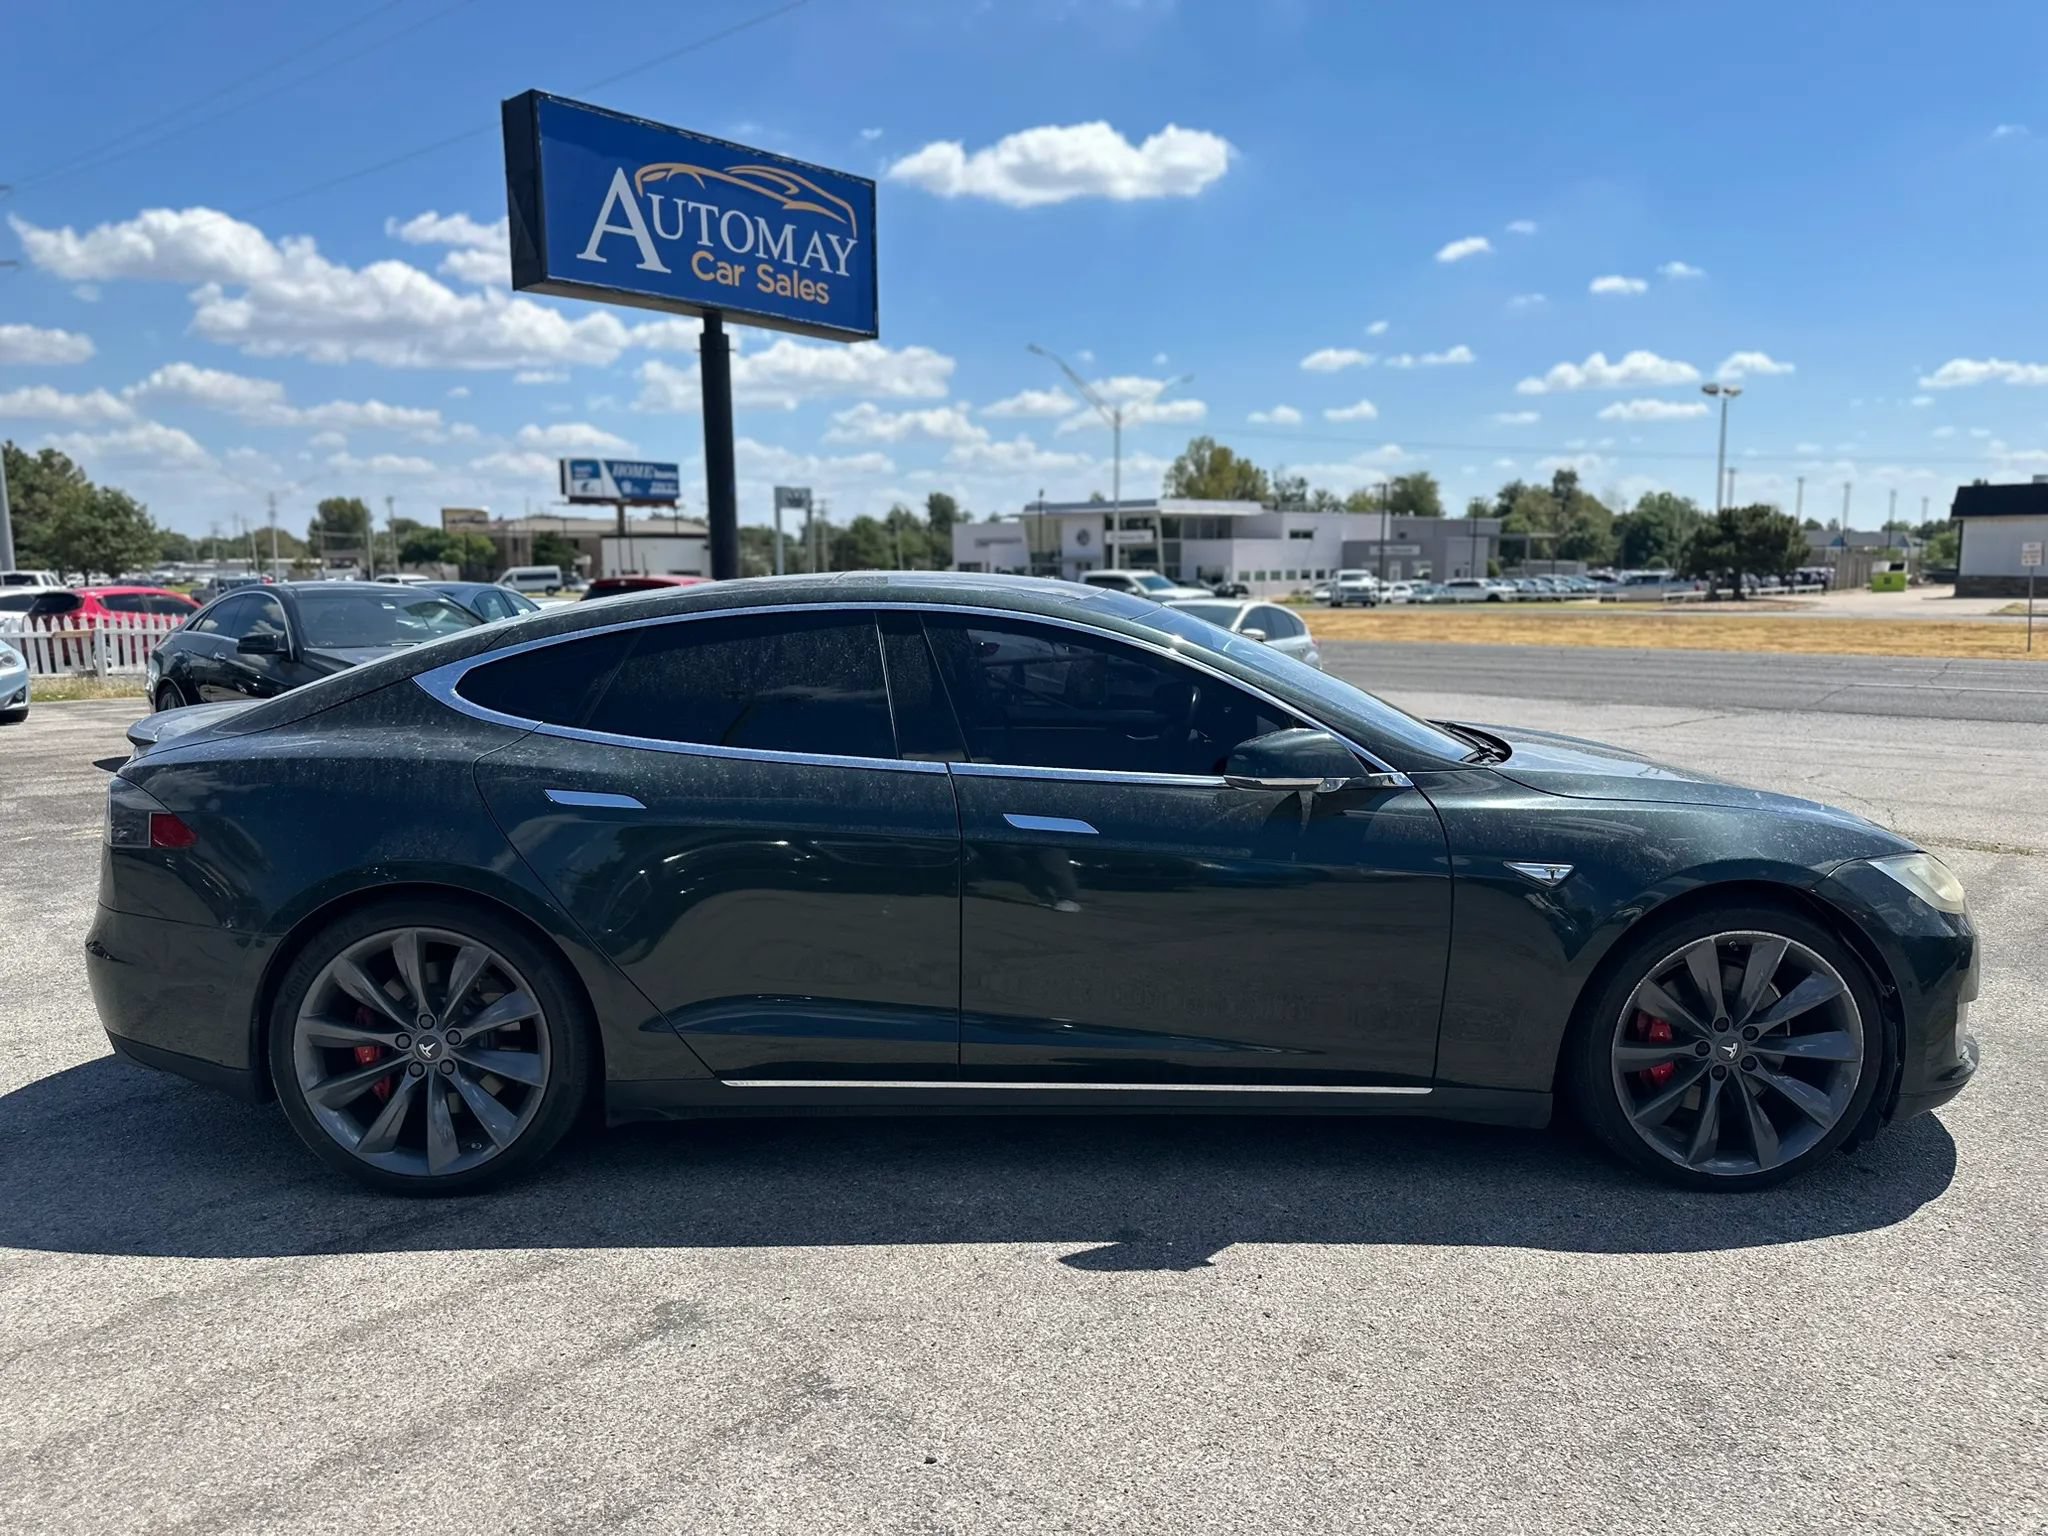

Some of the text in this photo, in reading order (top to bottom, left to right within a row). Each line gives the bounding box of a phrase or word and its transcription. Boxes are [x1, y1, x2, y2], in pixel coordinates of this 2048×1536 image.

[576, 167, 858, 277] AUTOMAY
[690, 251, 830, 305] Car Sales
